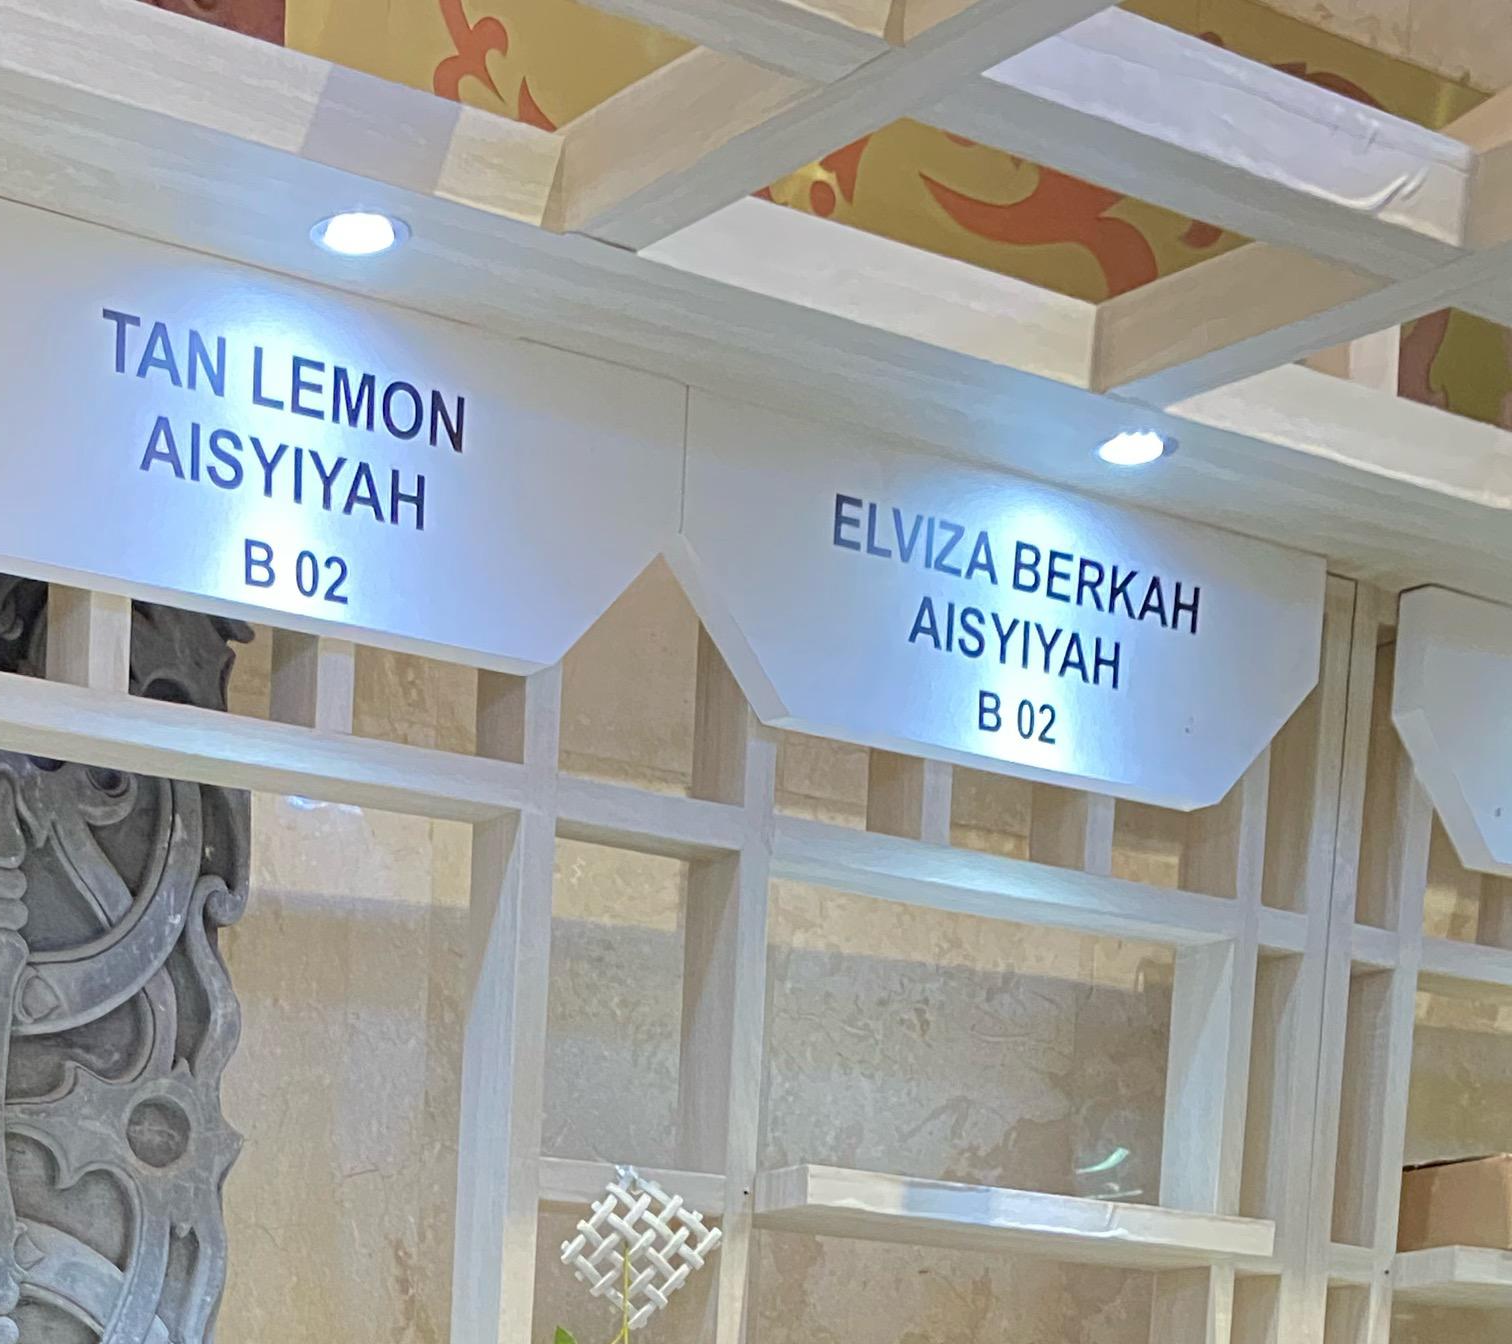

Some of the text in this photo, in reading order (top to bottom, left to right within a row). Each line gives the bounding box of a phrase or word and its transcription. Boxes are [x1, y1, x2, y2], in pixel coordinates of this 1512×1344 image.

[102, 308, 465, 453] TAN LEMON
[139, 415, 426, 531] AISYIYAH
[244, 538, 349, 605] B 02
[833, 493, 1201, 635] ELVIZA BERKAH
[908, 596, 1121, 690] AISYIYAH
[978, 690, 1057, 745] B 02
